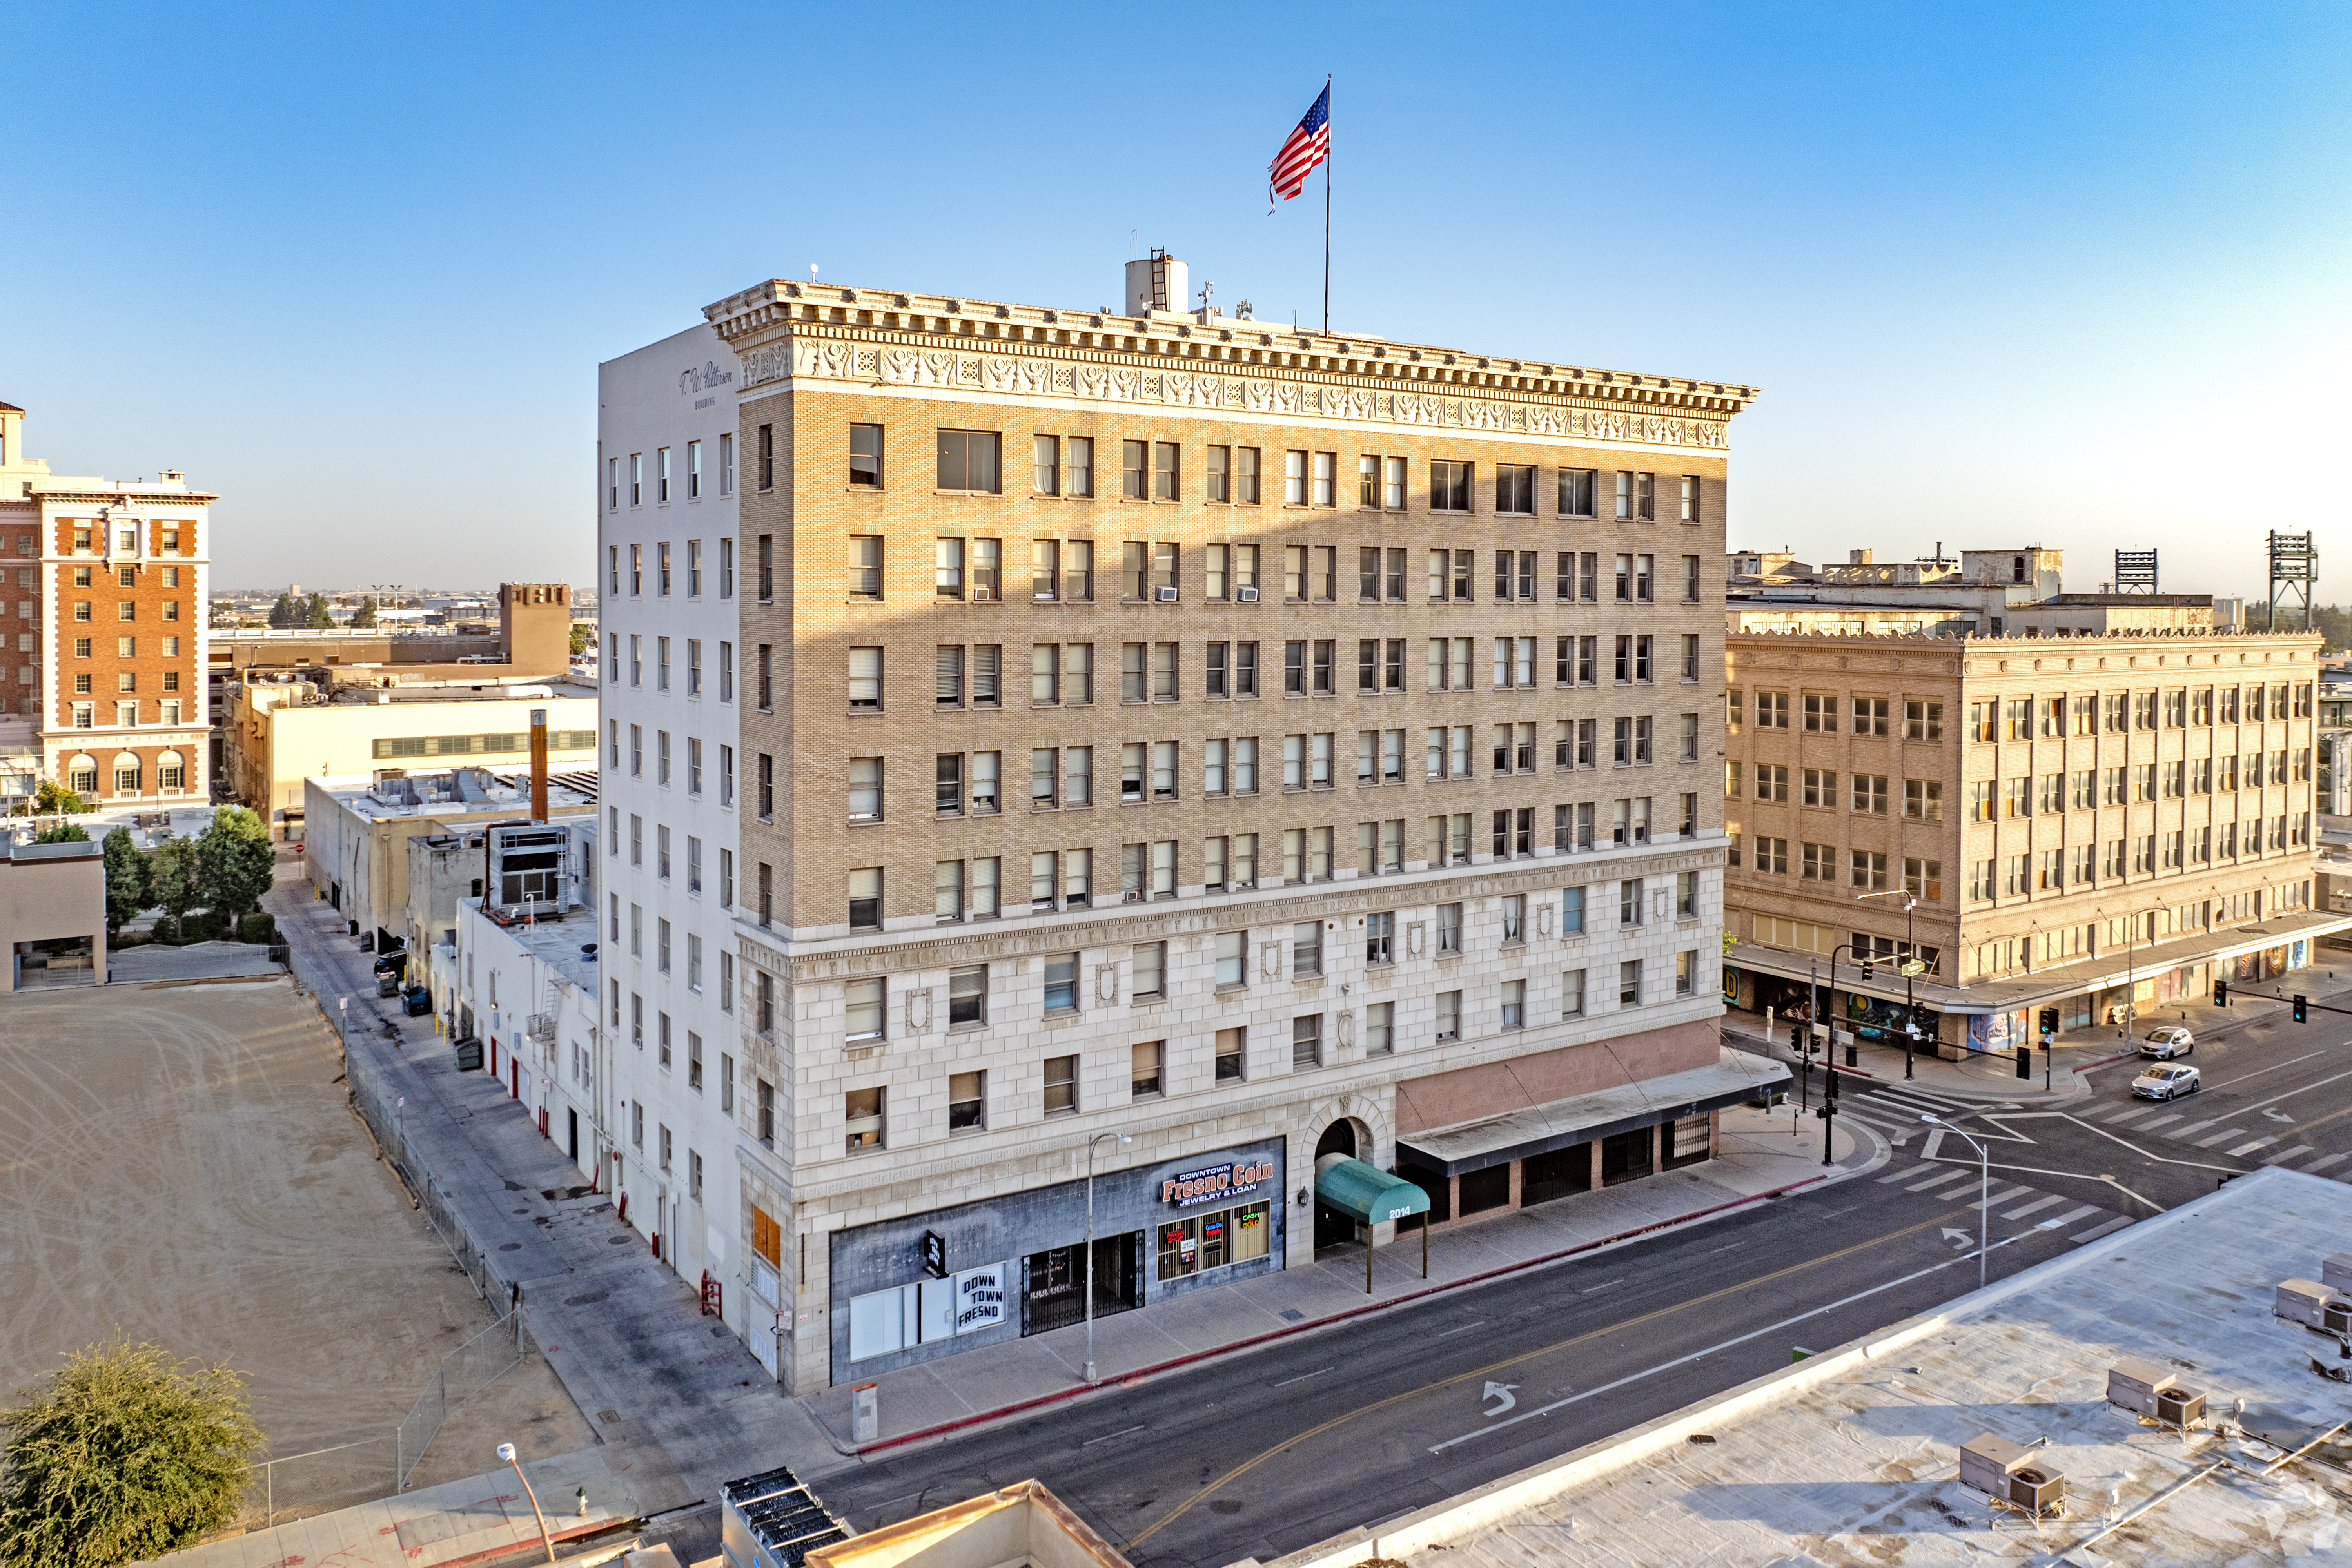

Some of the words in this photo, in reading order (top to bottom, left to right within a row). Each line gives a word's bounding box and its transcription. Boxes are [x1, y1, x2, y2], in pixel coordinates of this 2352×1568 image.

[703, 361, 733, 389] Patterson
[695, 396, 715, 410] BUILDING
[1296, 898, 1359, 916] PATTERSON
[1367, 891, 1419, 907] BUILDING
[1308, 1085, 1338, 1097] ERECTED
[1180, 1164, 1230, 1181] DOWNTOWN
[1163, 1173, 1228, 1202] Fresno
[1233, 1161, 1273, 1186] Coin
[1179, 1192, 1222, 1207] JEWELRY
[1232, 1183, 1256, 1195] LOAN
[1242, 1212, 1260, 1221] CASH
[1389, 1205, 1410, 1220] 2014
[964, 1275, 995, 1293] DOWN
[971, 1290, 1002, 1304] TOWN
[959, 1306, 998, 1327] FRESNO
